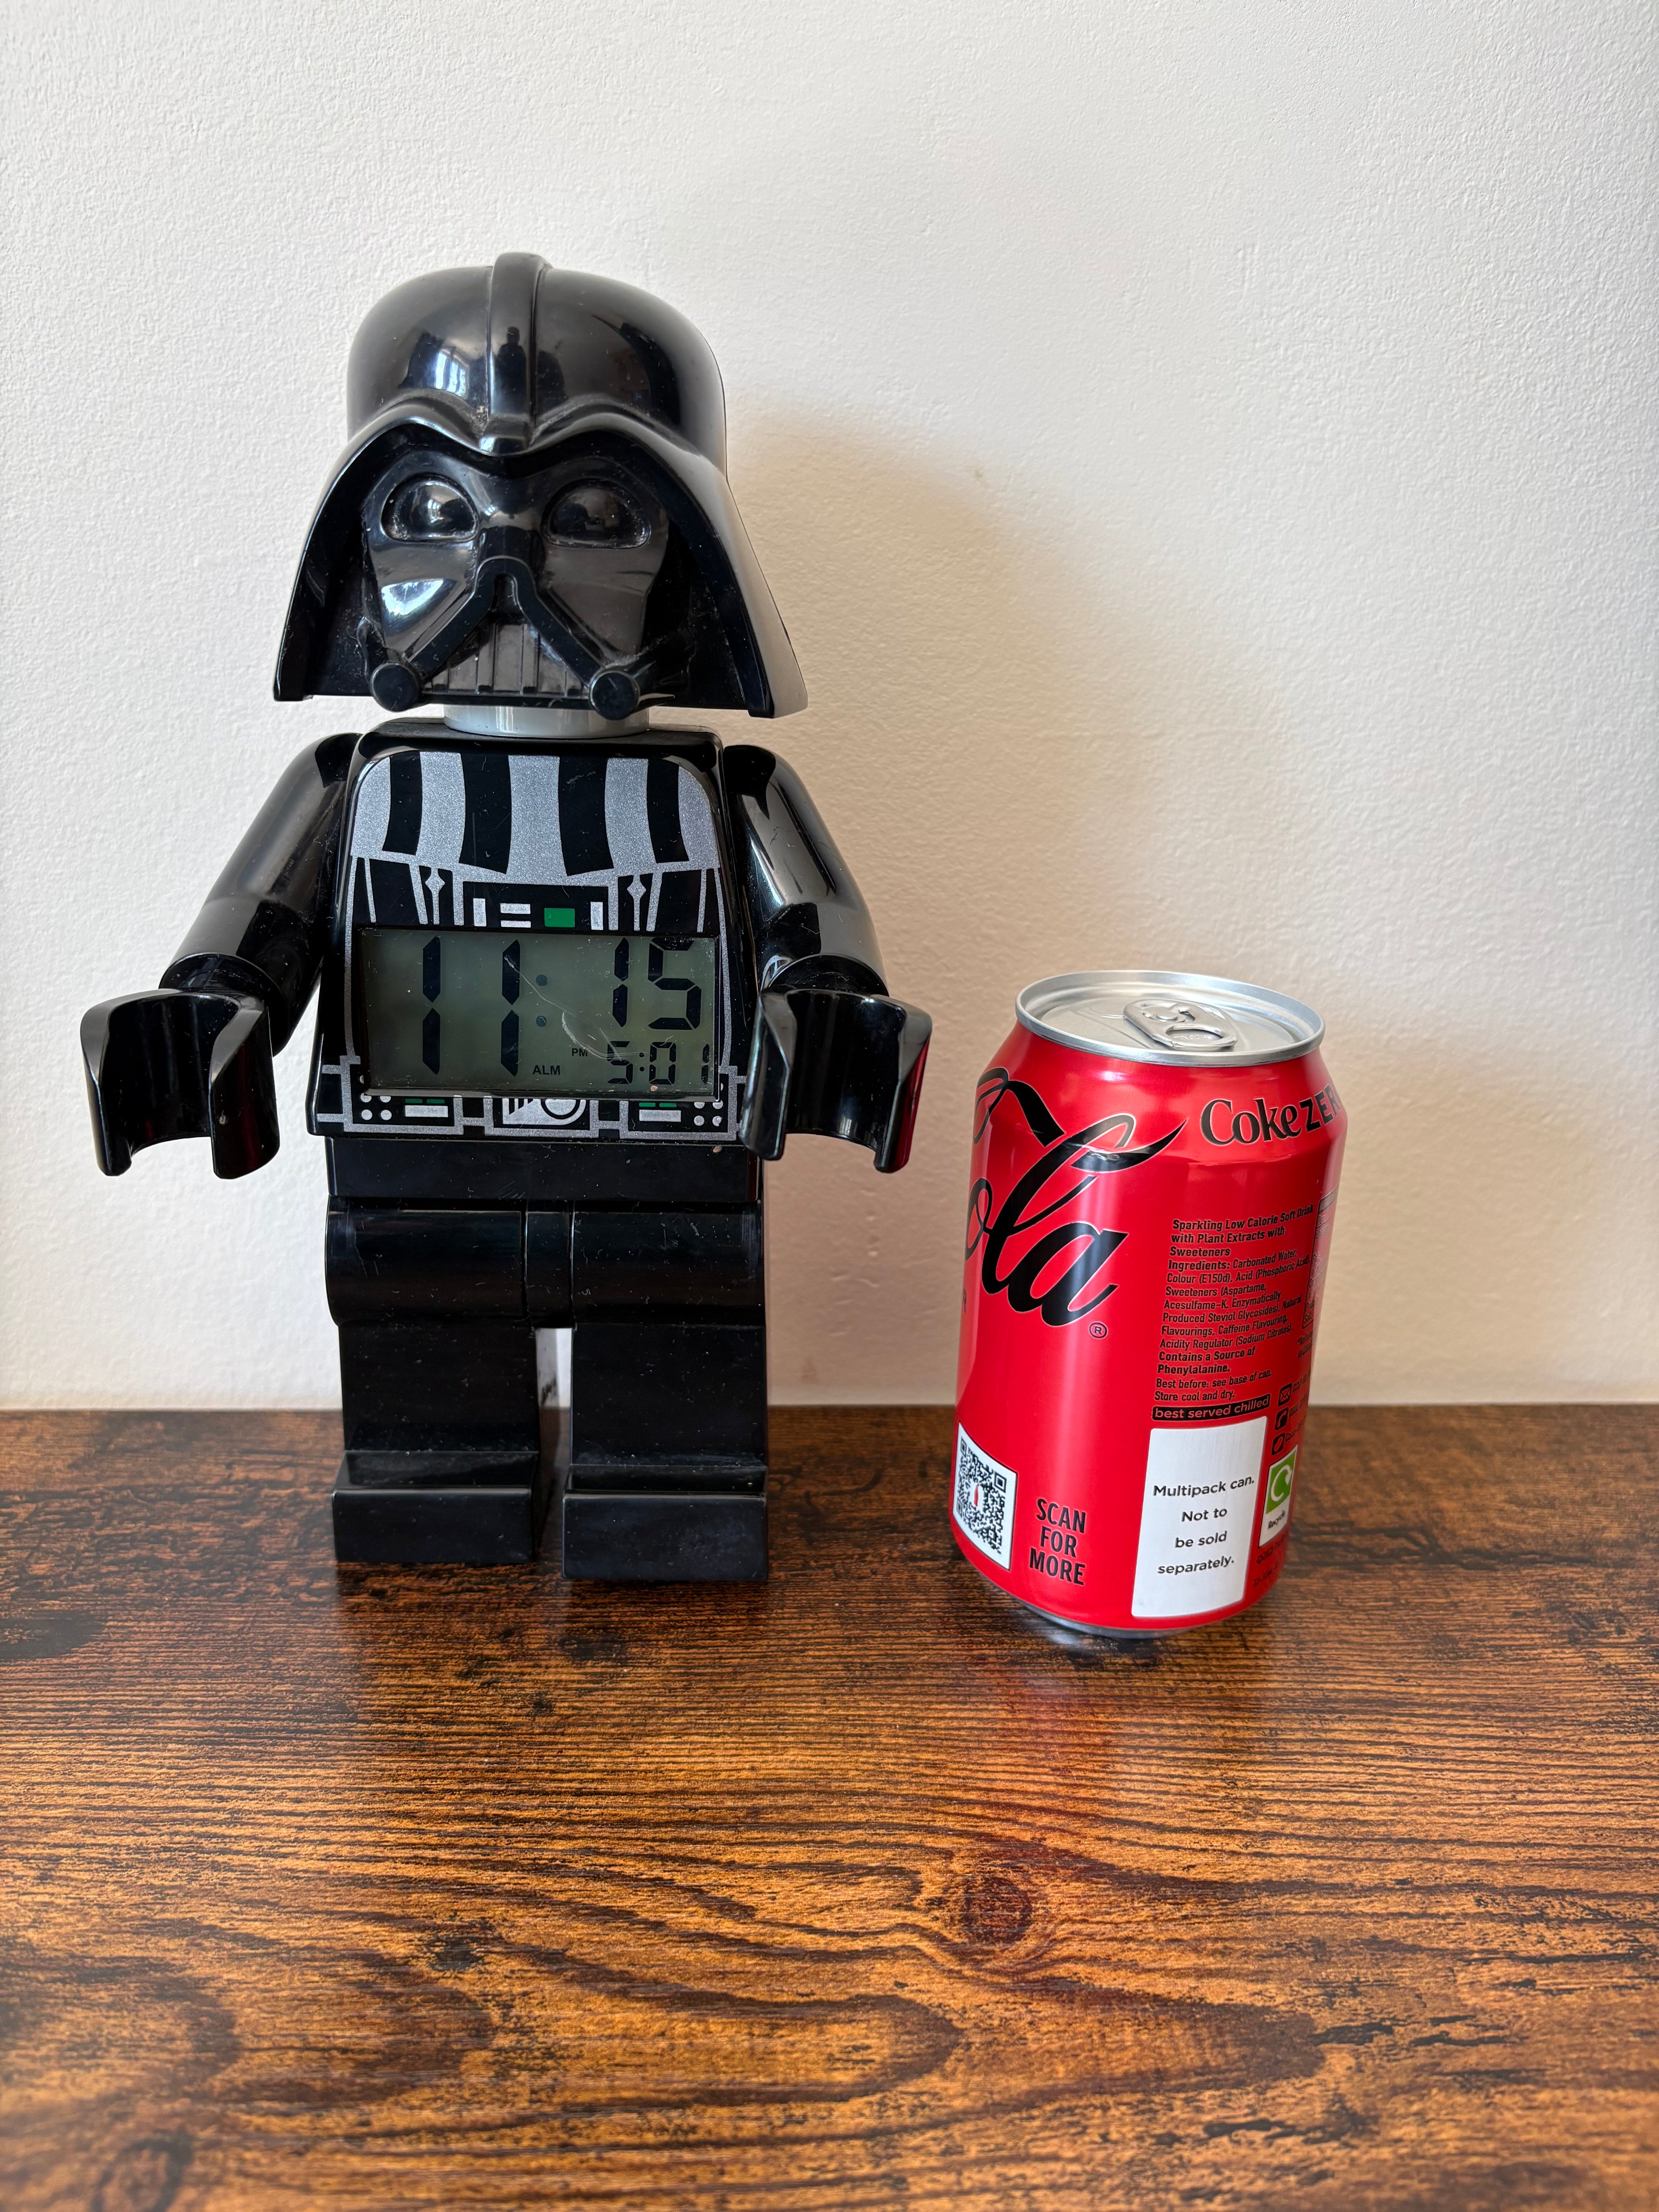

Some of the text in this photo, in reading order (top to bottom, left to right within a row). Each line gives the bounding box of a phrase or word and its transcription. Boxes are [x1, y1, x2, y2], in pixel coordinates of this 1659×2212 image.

[423, 936, 702, 1077] 11:15
[571, 1048, 588, 1057] PM
[532, 1065, 561, 1076] ALM
[607, 1041, 709, 1085] 5:01
[1172, 1204, 1314, 1232] Sparkling Low Calorie Soft Drink
[1171, 1226, 1285, 1243] with Plant Extracts with
[1170, 1246, 1231, 1257] Sweeteners
[1168, 1259, 1231, 1272] Ingredients:
[1233, 1254, 1276, 1269] Carbonated
[1167, 1273, 1197, 1283] Colour
[1235, 1271, 1253, 1282] Acid
[1255, 1262, 1295, 1280] (Phosphoric
[1165, 1286, 1218, 1297] Sweeteners
[1232, 1290, 1281, 1309] Enzymatically
[1162, 1312, 1205, 1323] Produced
[1208, 1311, 1236, 1322] Steviol
[1218, 1324, 1250, 1335] Caffeine
[1160, 1338, 1190, 1351] Acidity
[1192, 1338, 1233, 1351] Regulator
[1236, 1333, 1265, 1347] (Sodium
[1159, 1351, 1203, 1362] Contains
[1214, 1349, 1245, 1360] Source
[1246, 1345, 1256, 1356] of
[1157, 1363, 1230, 1376] Phenylalanine.
[1156, 1378, 1176, 1389] Best
[1178, 1379, 1209, 1389] before:
[1212, 1379, 1227, 1387] see
[1229, 1376, 1248, 1386] base
[1249, 1371, 1258, 1382] of
[1154, 1389, 1235, 1401] Store cool and dry.
[1155, 1395, 1269, 1418] best served chilled
[1153, 1476, 1254, 1498] Multipack can.
[1036, 1498, 1086, 1534] SCAN
[1181, 1508, 1227, 1522] Not to
[1040, 1526, 1077, 1558] FOR
[1175, 1530, 1227, 1548] be sold
[1029, 1547, 1086, 1586] MORE
[1157, 1555, 1234, 1575] separately.
